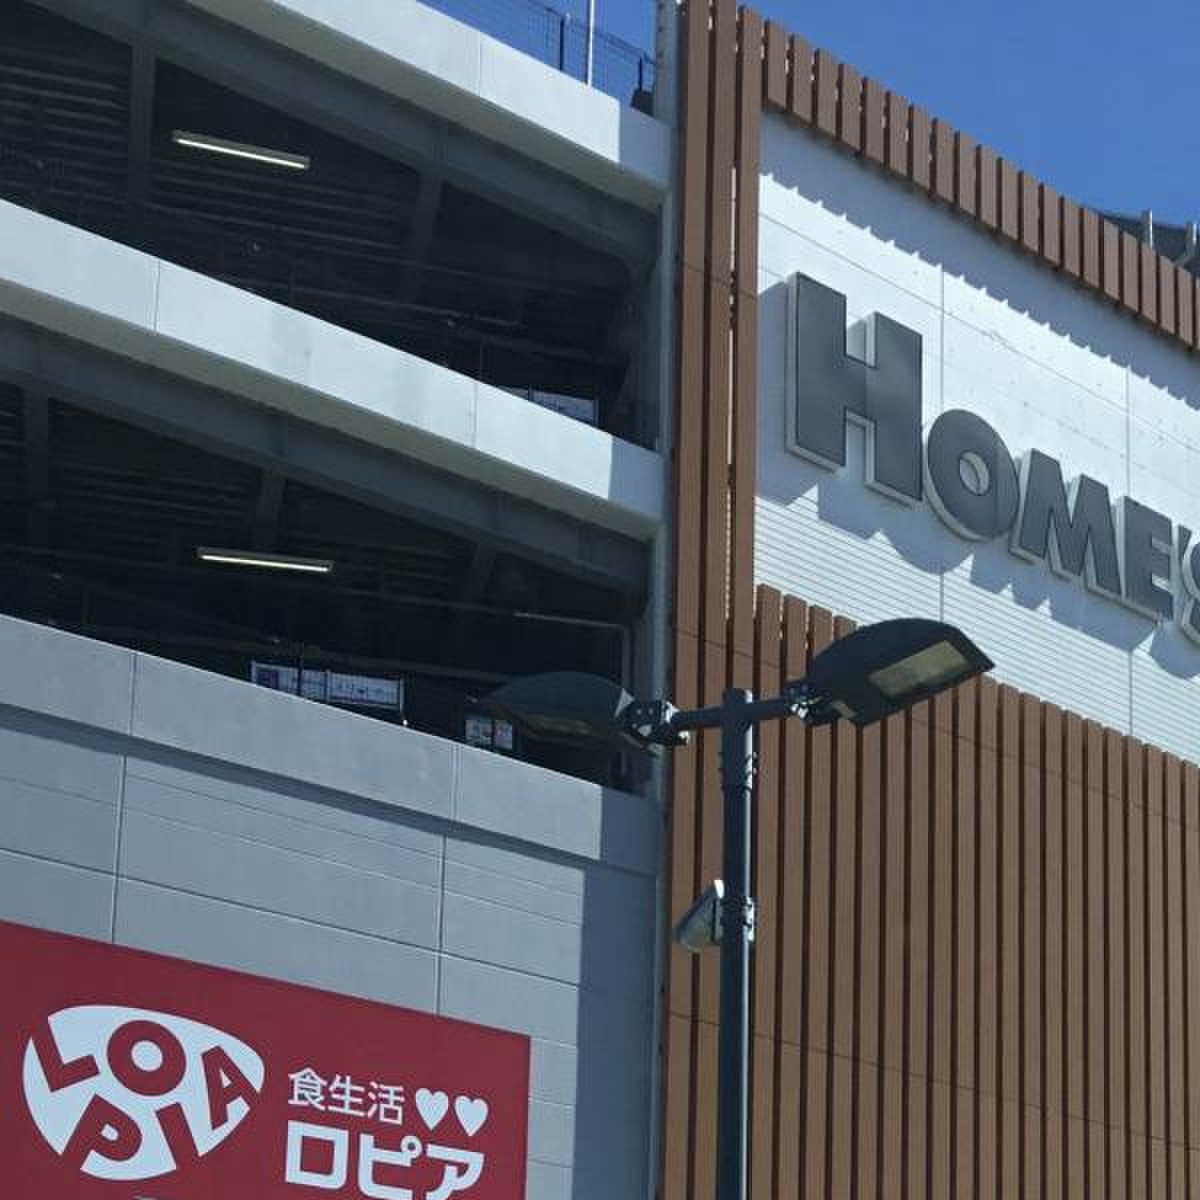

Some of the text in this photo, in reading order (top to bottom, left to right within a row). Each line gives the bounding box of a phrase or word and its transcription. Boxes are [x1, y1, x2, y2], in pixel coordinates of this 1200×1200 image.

[23, 1004, 265, 1181] LOPIA
[287, 1067, 405, 1125] 食生活
